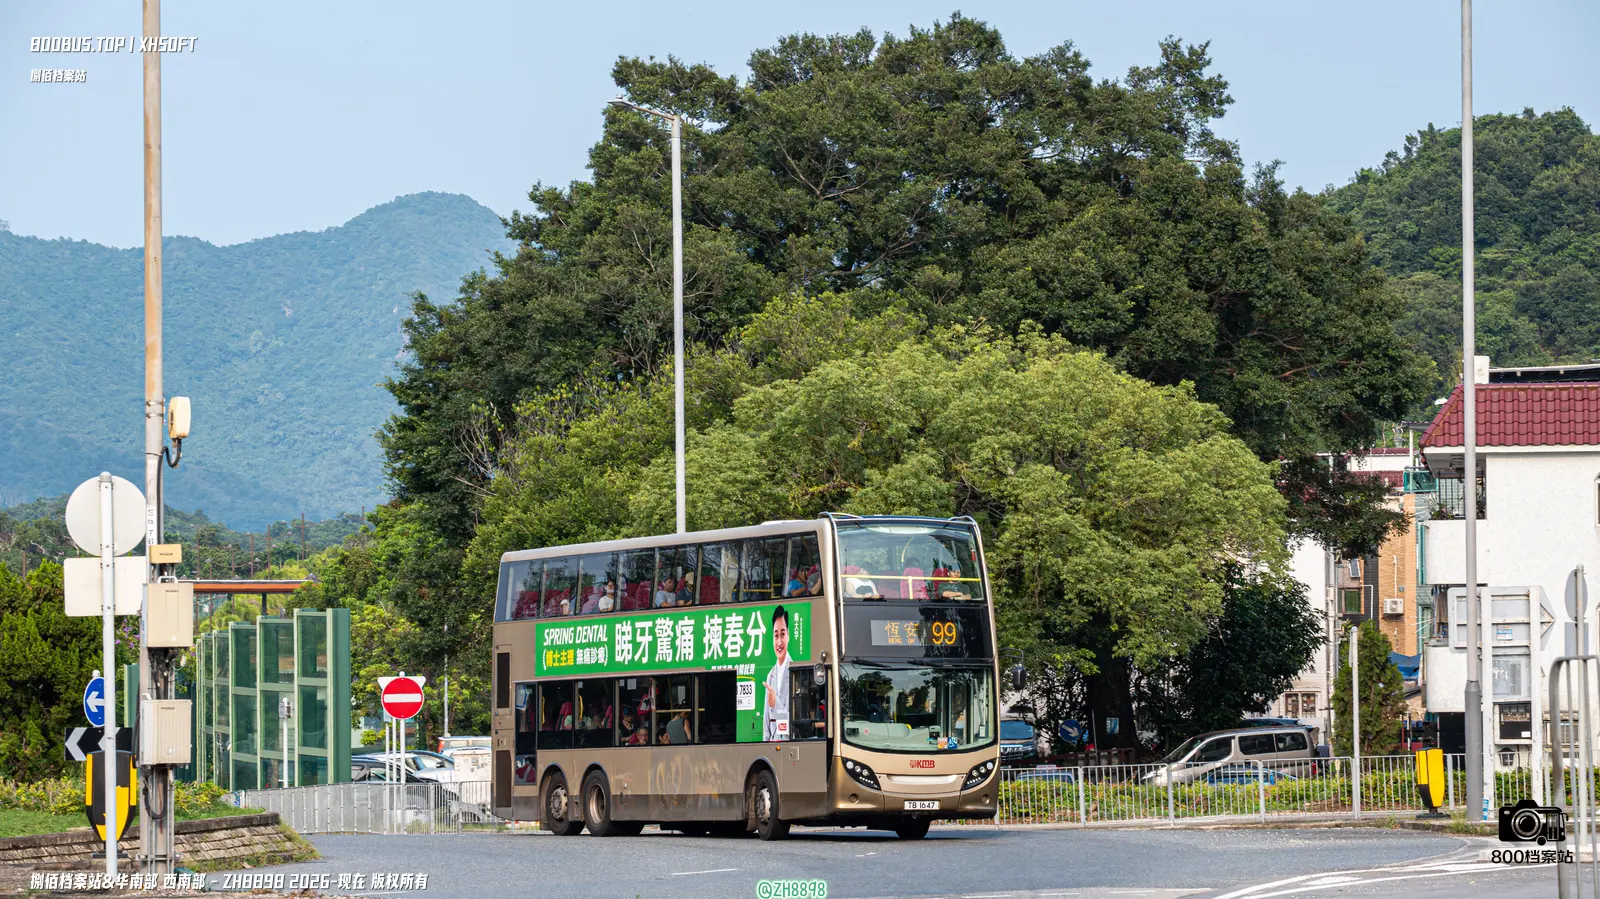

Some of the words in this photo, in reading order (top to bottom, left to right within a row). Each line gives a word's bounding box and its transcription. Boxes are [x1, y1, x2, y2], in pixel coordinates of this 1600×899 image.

[543, 626, 575, 646] SPRING
[576, 624, 608, 645] DENTAL
[615, 616, 695, 665] 睇牙驚痛
[703, 610, 767, 660] 揀春分
[885, 621, 919, 638] 恆安
[931, 621, 957, 645] 99
[915, 759, 936, 769] KMB
